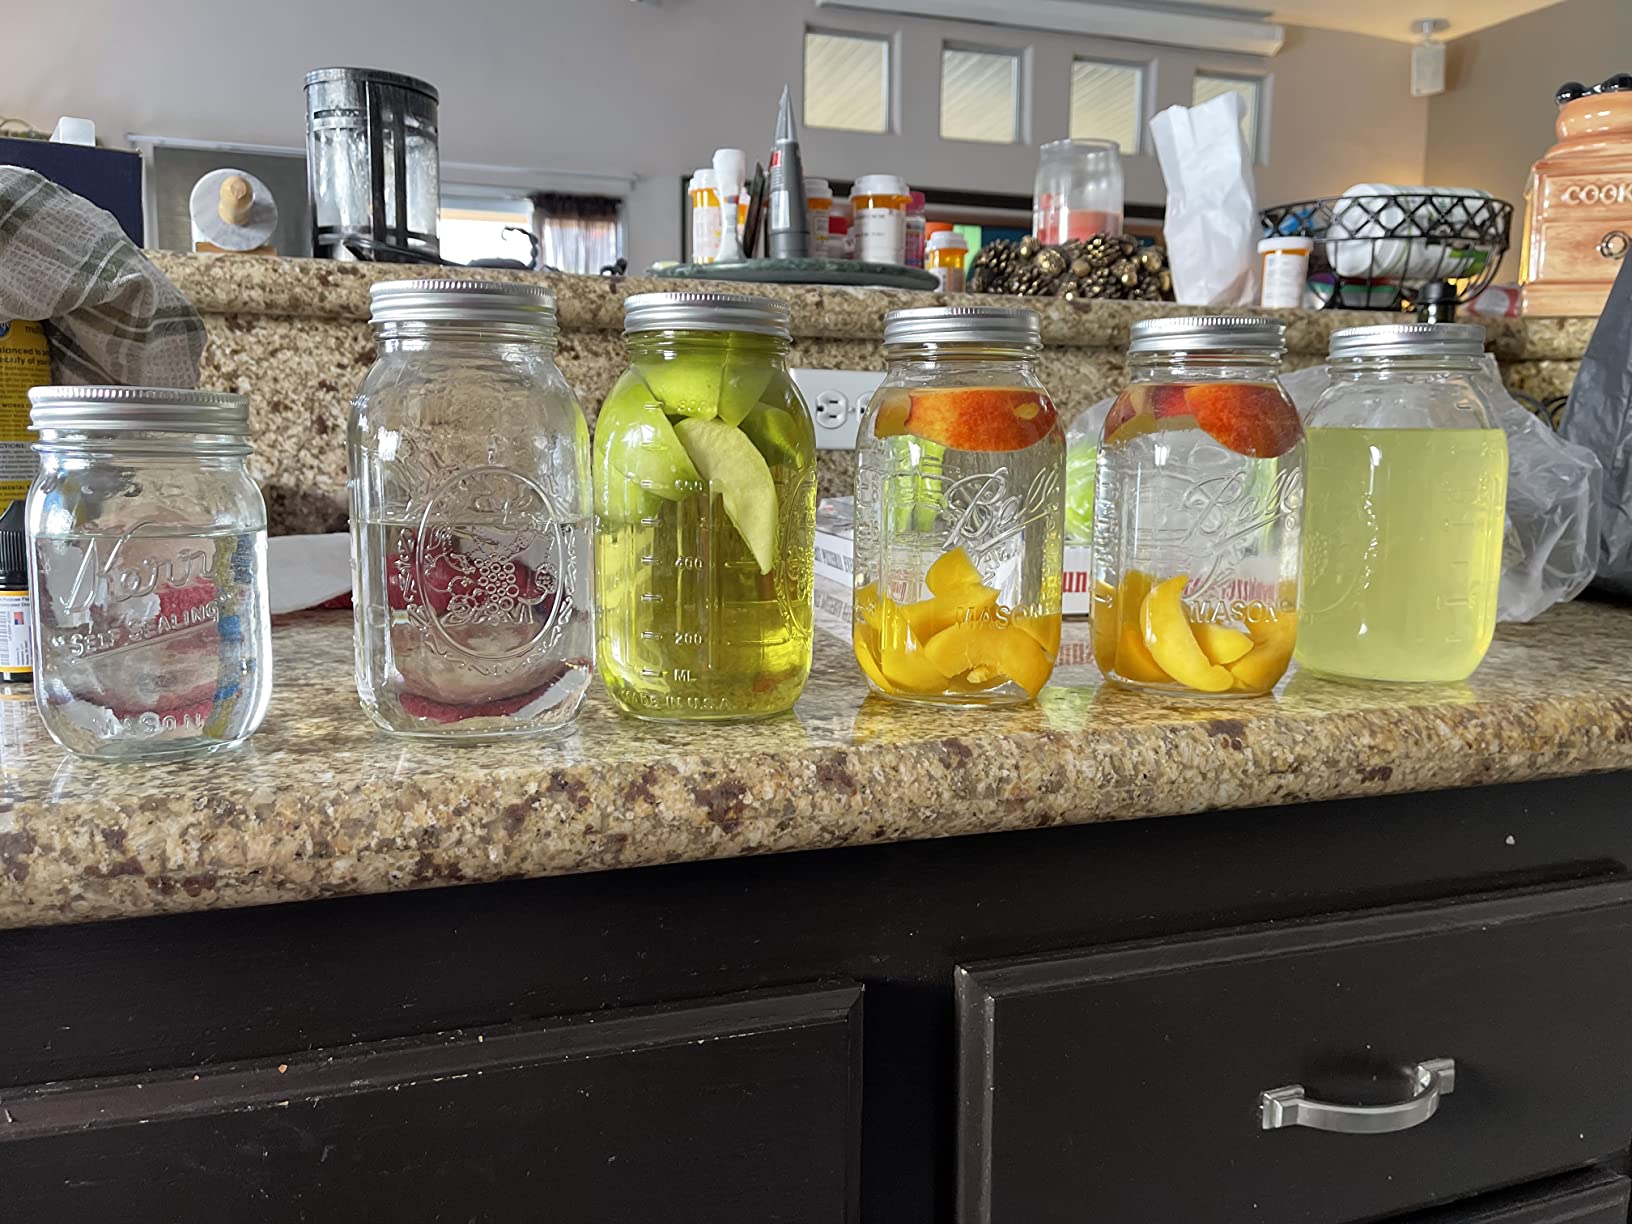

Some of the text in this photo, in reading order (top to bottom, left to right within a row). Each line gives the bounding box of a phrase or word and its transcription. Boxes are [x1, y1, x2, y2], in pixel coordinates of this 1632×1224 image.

[1182, 466, 1304, 545] Ball
[60, 521, 217, 614] Kerr
[954, 604, 1043, 629] MASON
[1189, 600, 1279, 624] MASON
[674, 631, 703, 645] 200
[674, 668, 697, 682] ML
[665, 696, 681, 708] IN
[92, 712, 206, 739] MASON
